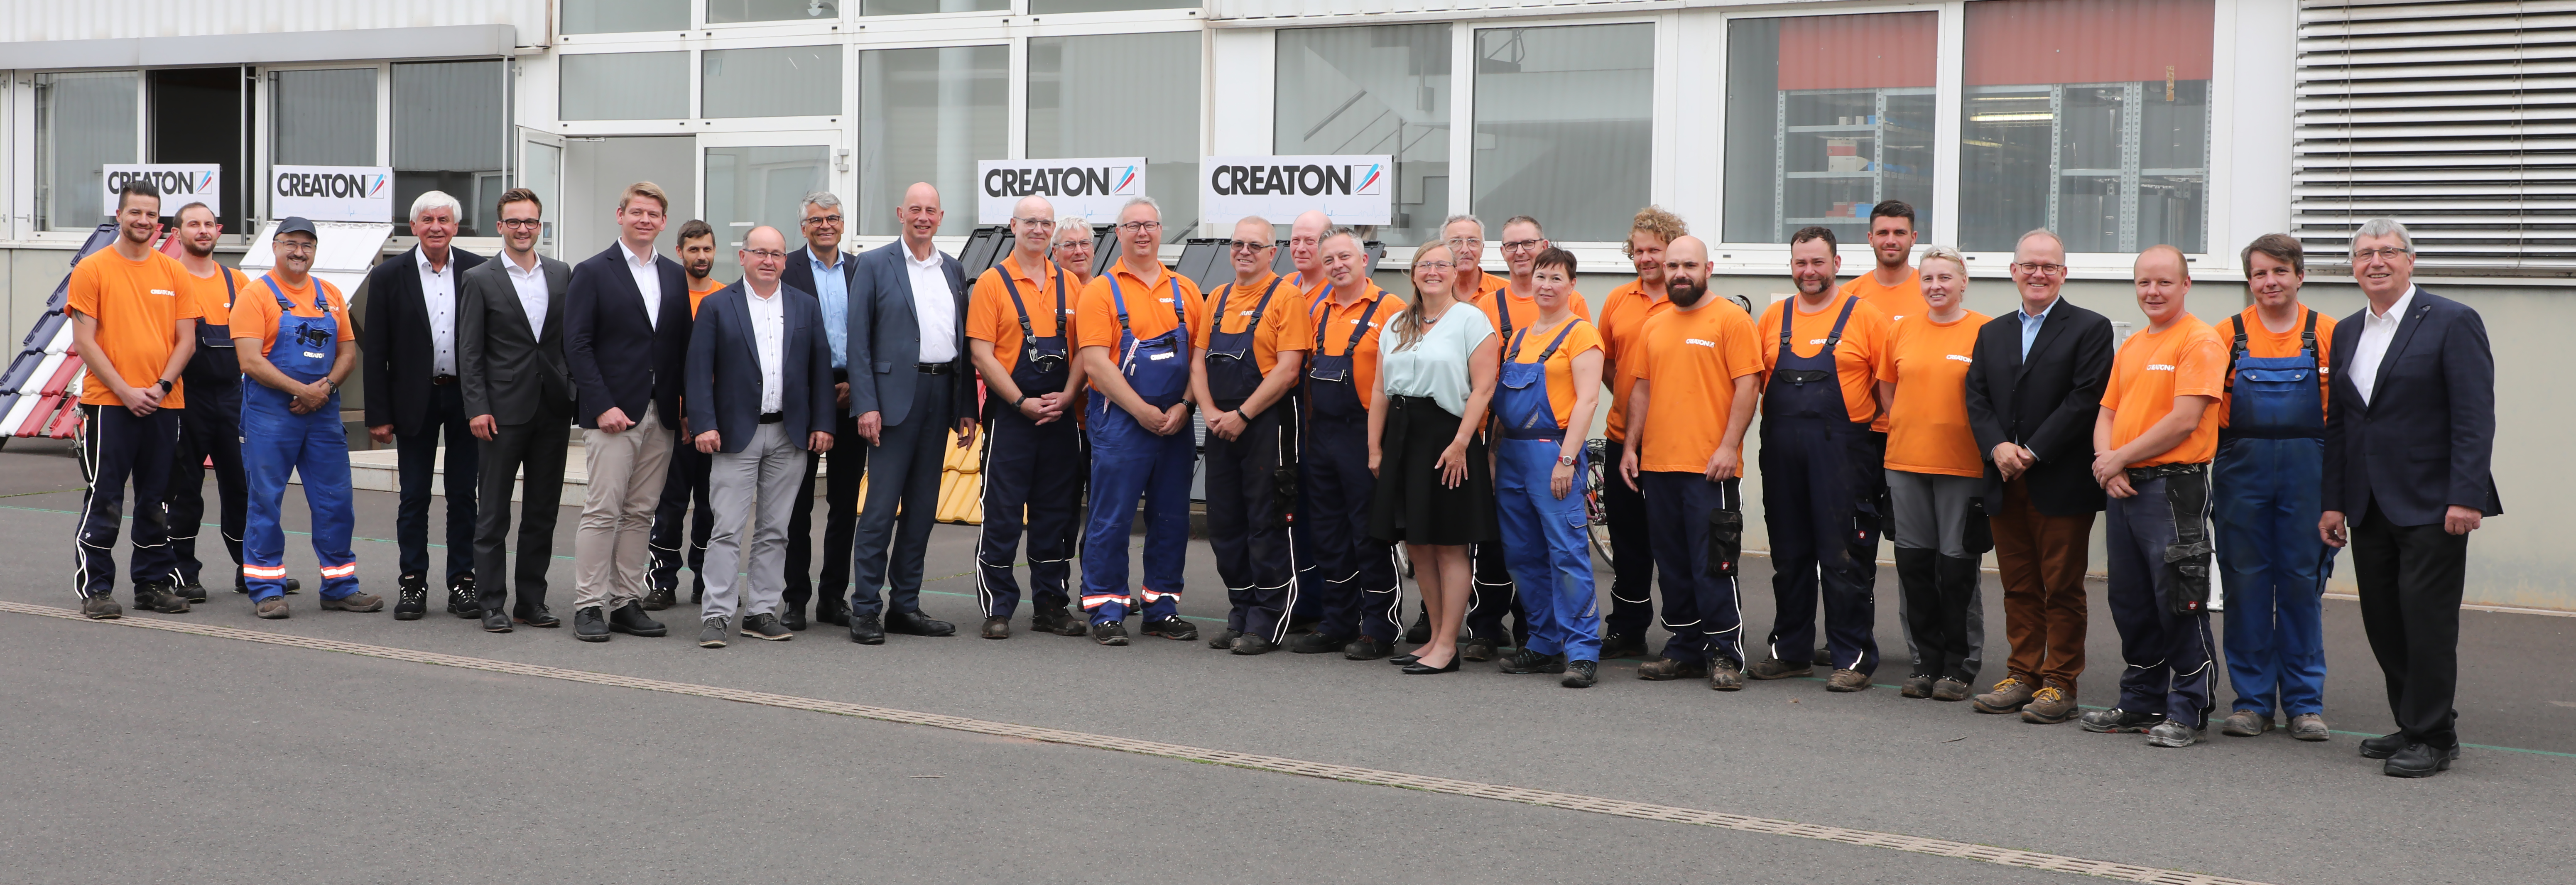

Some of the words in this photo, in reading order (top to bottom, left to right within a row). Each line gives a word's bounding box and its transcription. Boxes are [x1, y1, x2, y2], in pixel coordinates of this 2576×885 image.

[277, 173, 366, 198] CREATON
[985, 167, 1109, 198] CREATON
[1212, 164, 1351, 196] CREATON
[1946, 354, 1973, 363] CREATON
